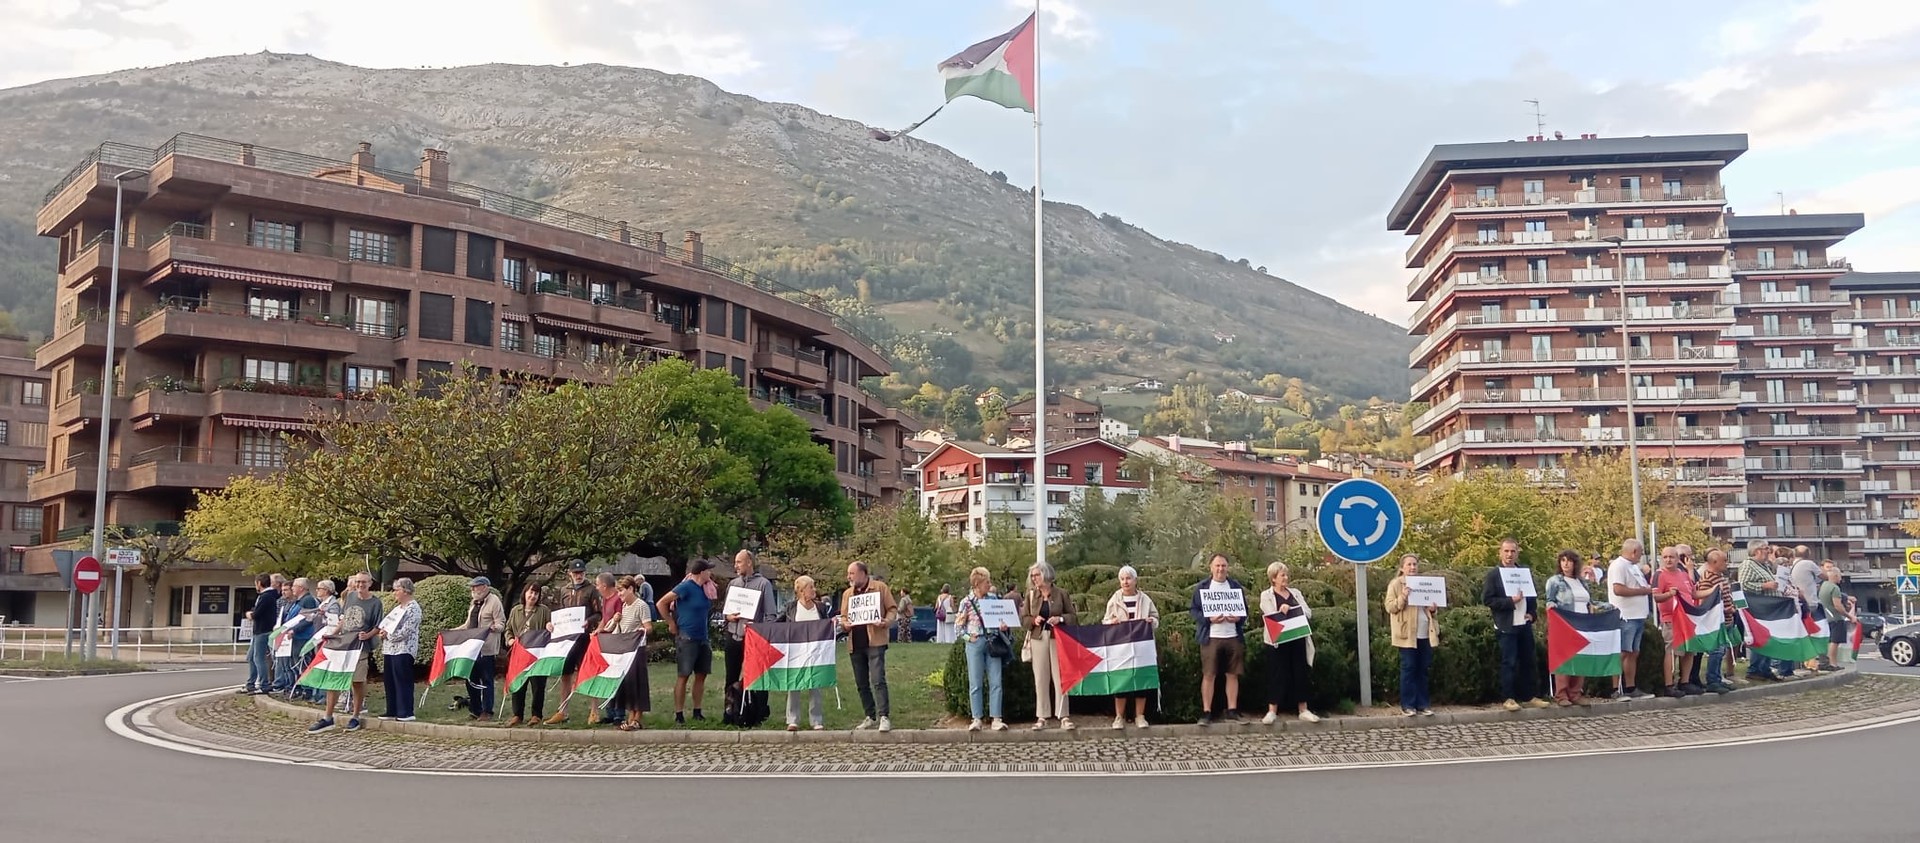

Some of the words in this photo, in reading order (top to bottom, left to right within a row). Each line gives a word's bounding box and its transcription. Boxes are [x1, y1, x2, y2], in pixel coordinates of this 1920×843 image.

[1203, 591, 1240, 600] PALESTINARI
[851, 594, 876, 608] ISRAELI
[1202, 603, 1245, 612] ELKARTASUNA
